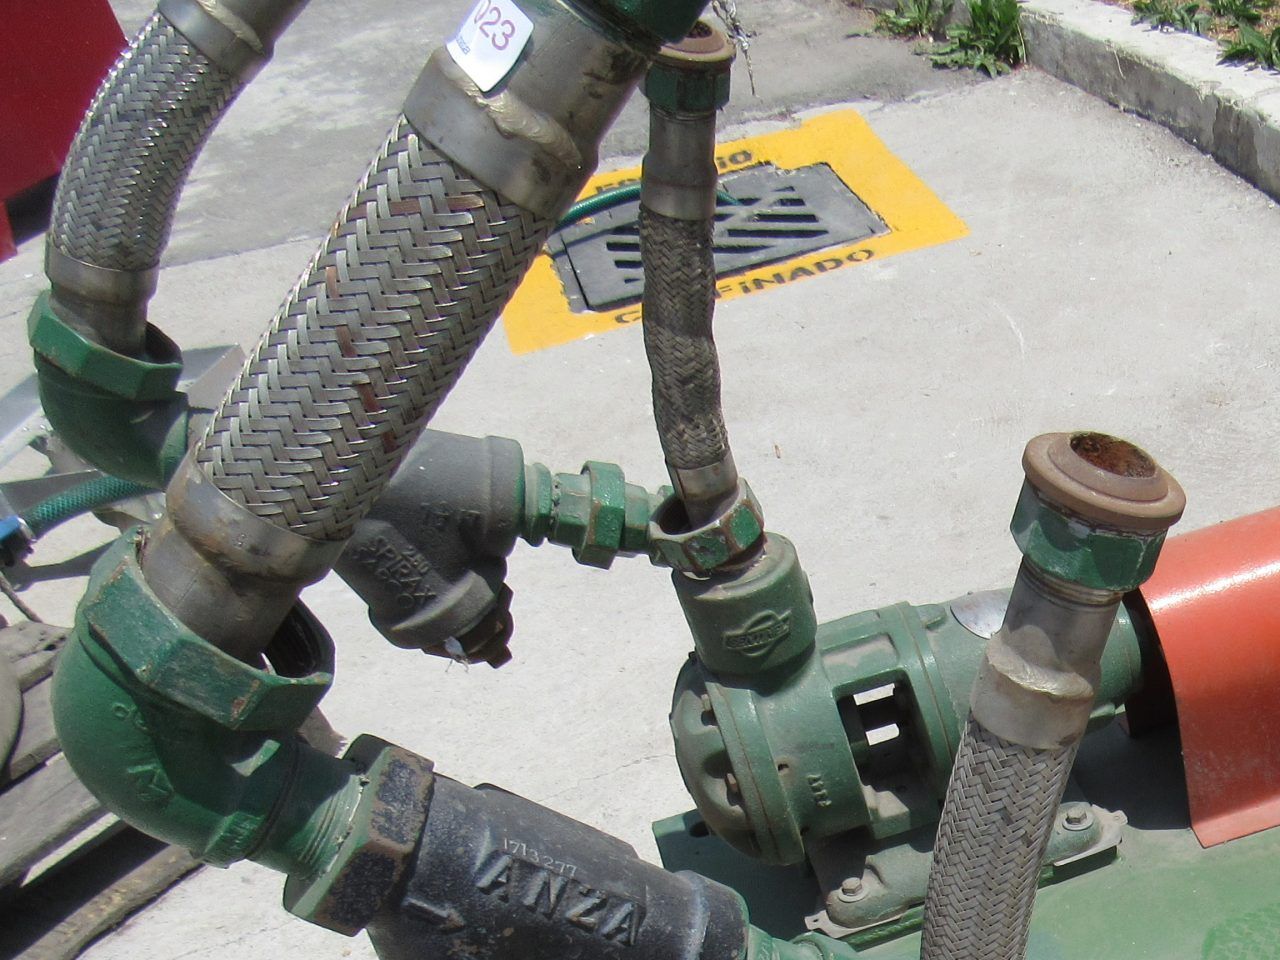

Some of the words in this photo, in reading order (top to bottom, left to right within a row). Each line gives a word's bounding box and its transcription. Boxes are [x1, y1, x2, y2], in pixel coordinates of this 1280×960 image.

[614, 248, 875, 325] CFINADO
[369, 536, 438, 605] SPIRAX
[475, 850, 646, 947] ANZA
